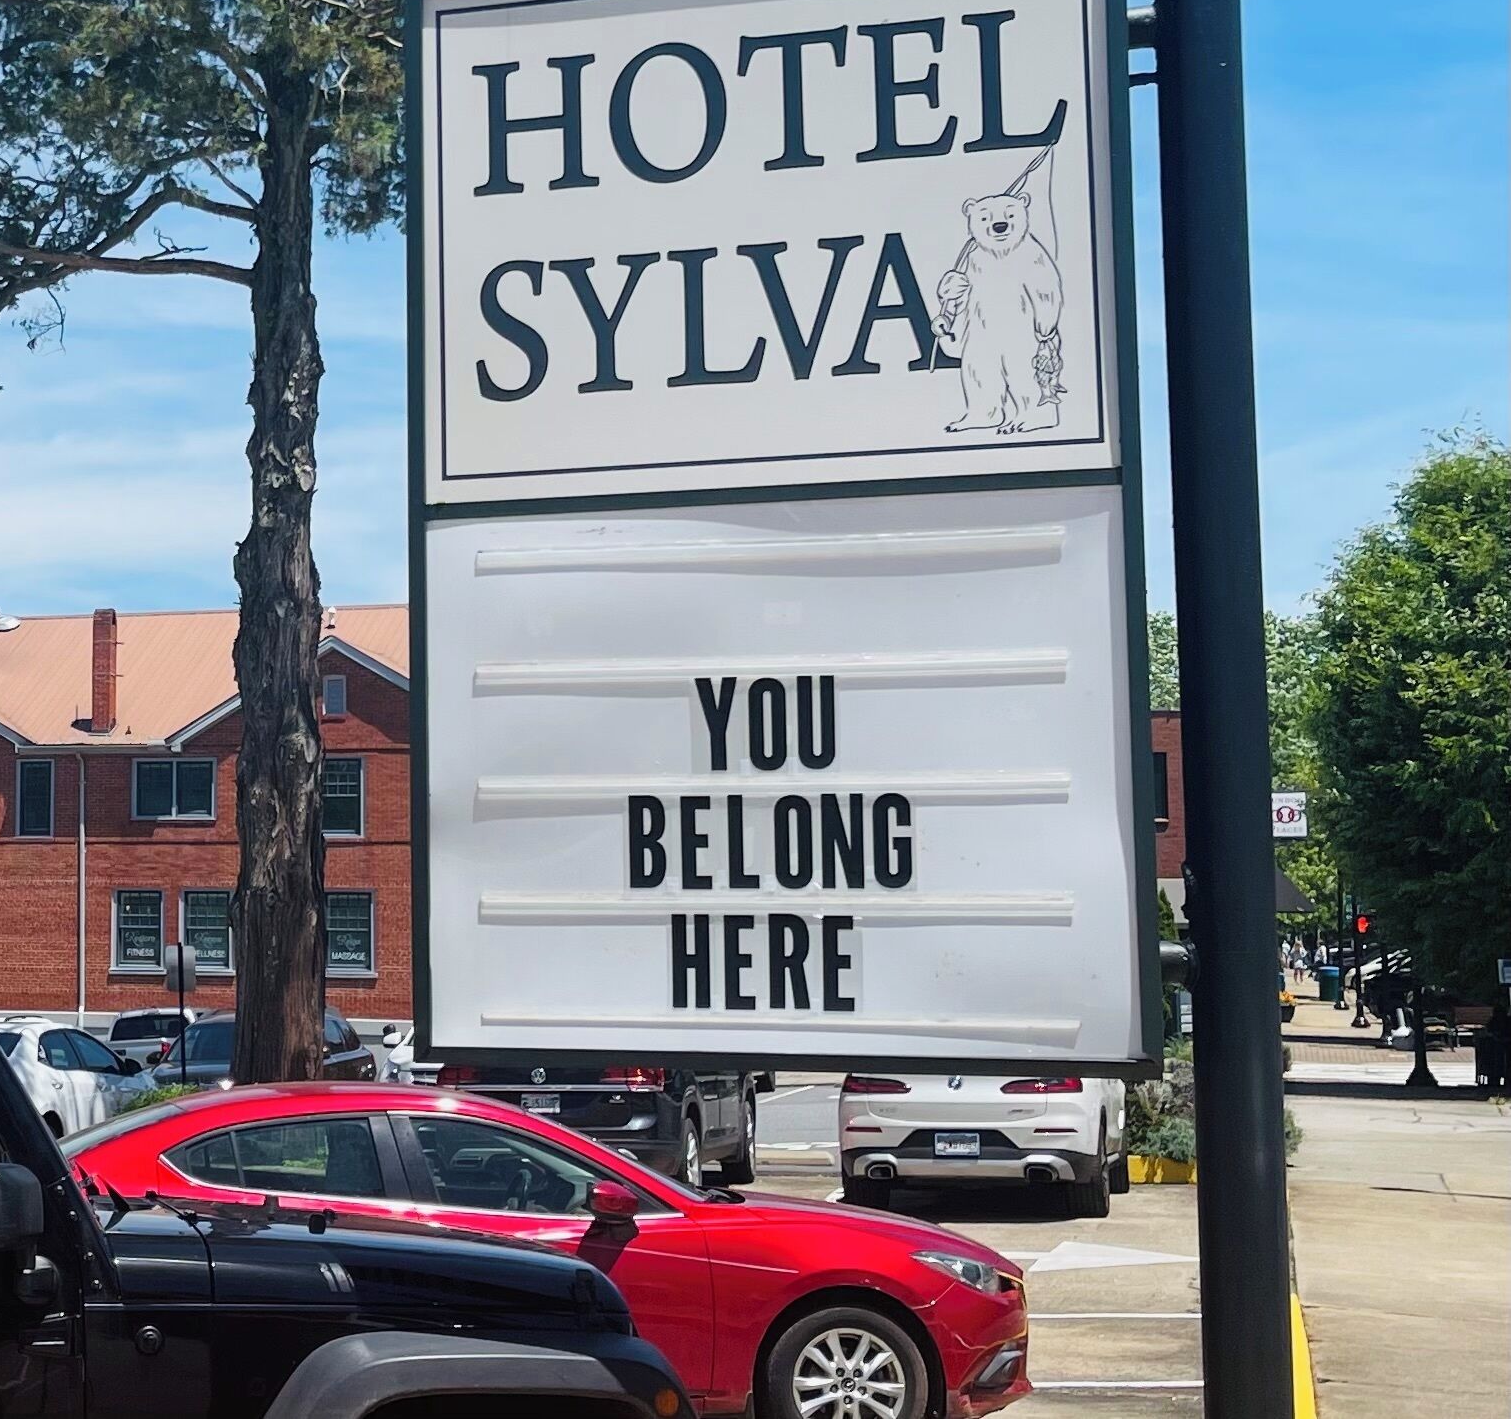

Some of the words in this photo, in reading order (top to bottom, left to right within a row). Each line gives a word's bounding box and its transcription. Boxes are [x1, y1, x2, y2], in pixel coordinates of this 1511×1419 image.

[471, 9, 1068, 198] HOTEL
[475, 232, 964, 403] SYLVA
[694, 675, 837, 771] YOU
[628, 792, 913, 890] BELONG
[126, 947, 155, 957] FITNESS
[195, 949, 227, 959] ELLNESS
[331, 951, 366, 961] MASSAGE
[671, 913, 856, 1012] HERE
